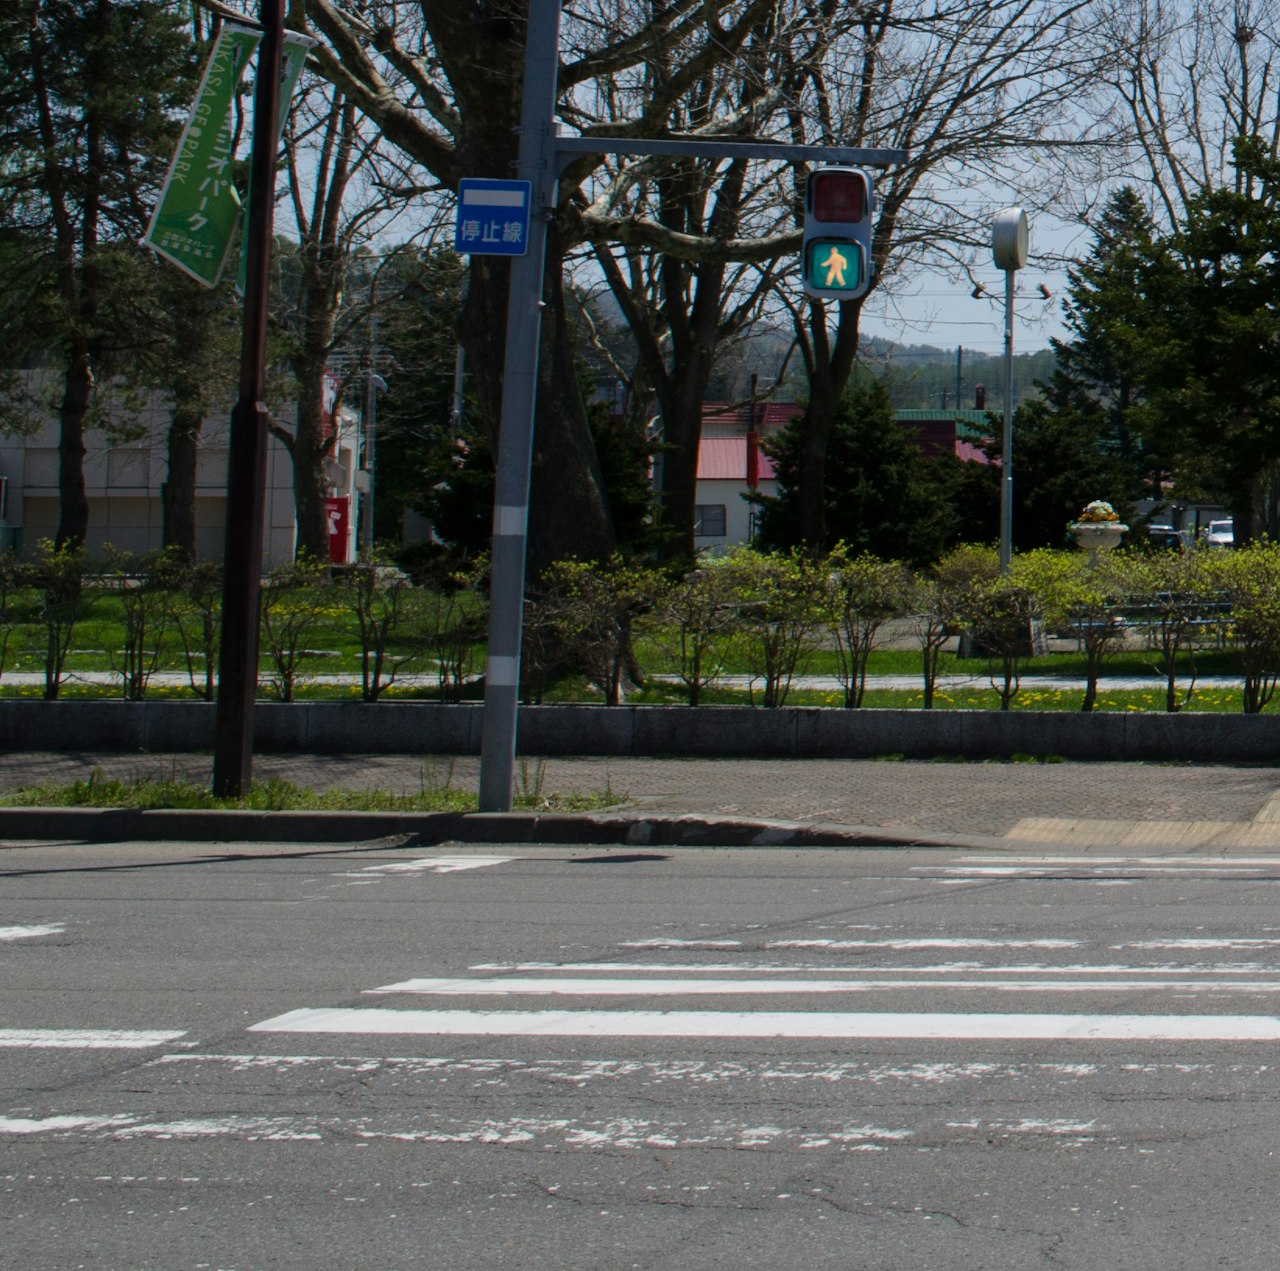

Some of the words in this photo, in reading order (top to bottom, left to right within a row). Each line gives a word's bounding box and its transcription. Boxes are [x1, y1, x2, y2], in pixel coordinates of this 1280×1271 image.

[201, 30, 234, 98] MIKASA
[461, 219, 523, 243] 停止線
